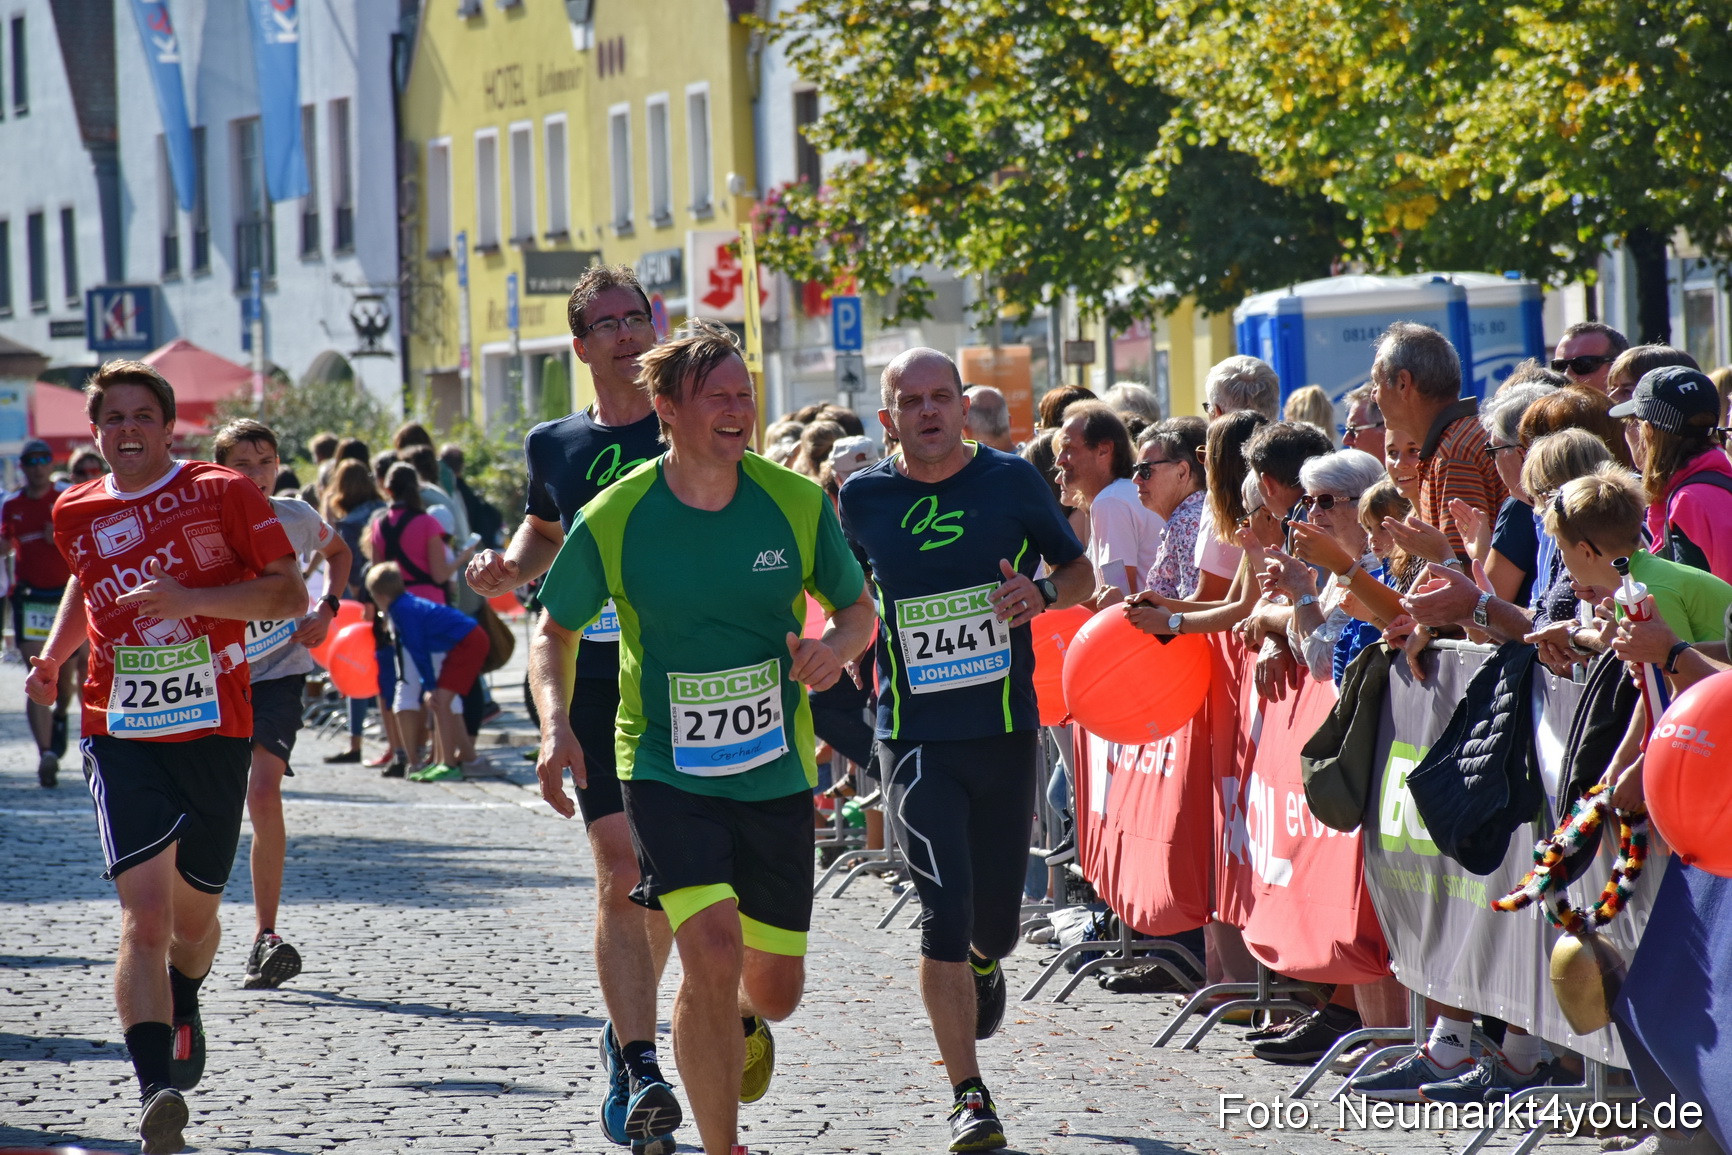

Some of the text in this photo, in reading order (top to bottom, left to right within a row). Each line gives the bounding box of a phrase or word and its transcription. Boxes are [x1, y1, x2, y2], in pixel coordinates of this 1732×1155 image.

[483, 63, 527, 112] HOTEL
[838, 303, 856, 347] P
[753, 548, 787, 567] AOK
[904, 589, 991, 623] BOCK
[912, 619, 996, 659] 2441
[120, 643, 203, 671] BOCK
[918, 656, 1004, 682] JOHANNES
[121, 673, 203, 708] 2264
[678, 666, 774, 701] BOCK
[124, 708, 202, 728] RAIMUND
[684, 697, 772, 741] 2705
[1672, 740, 1712, 757] energie
